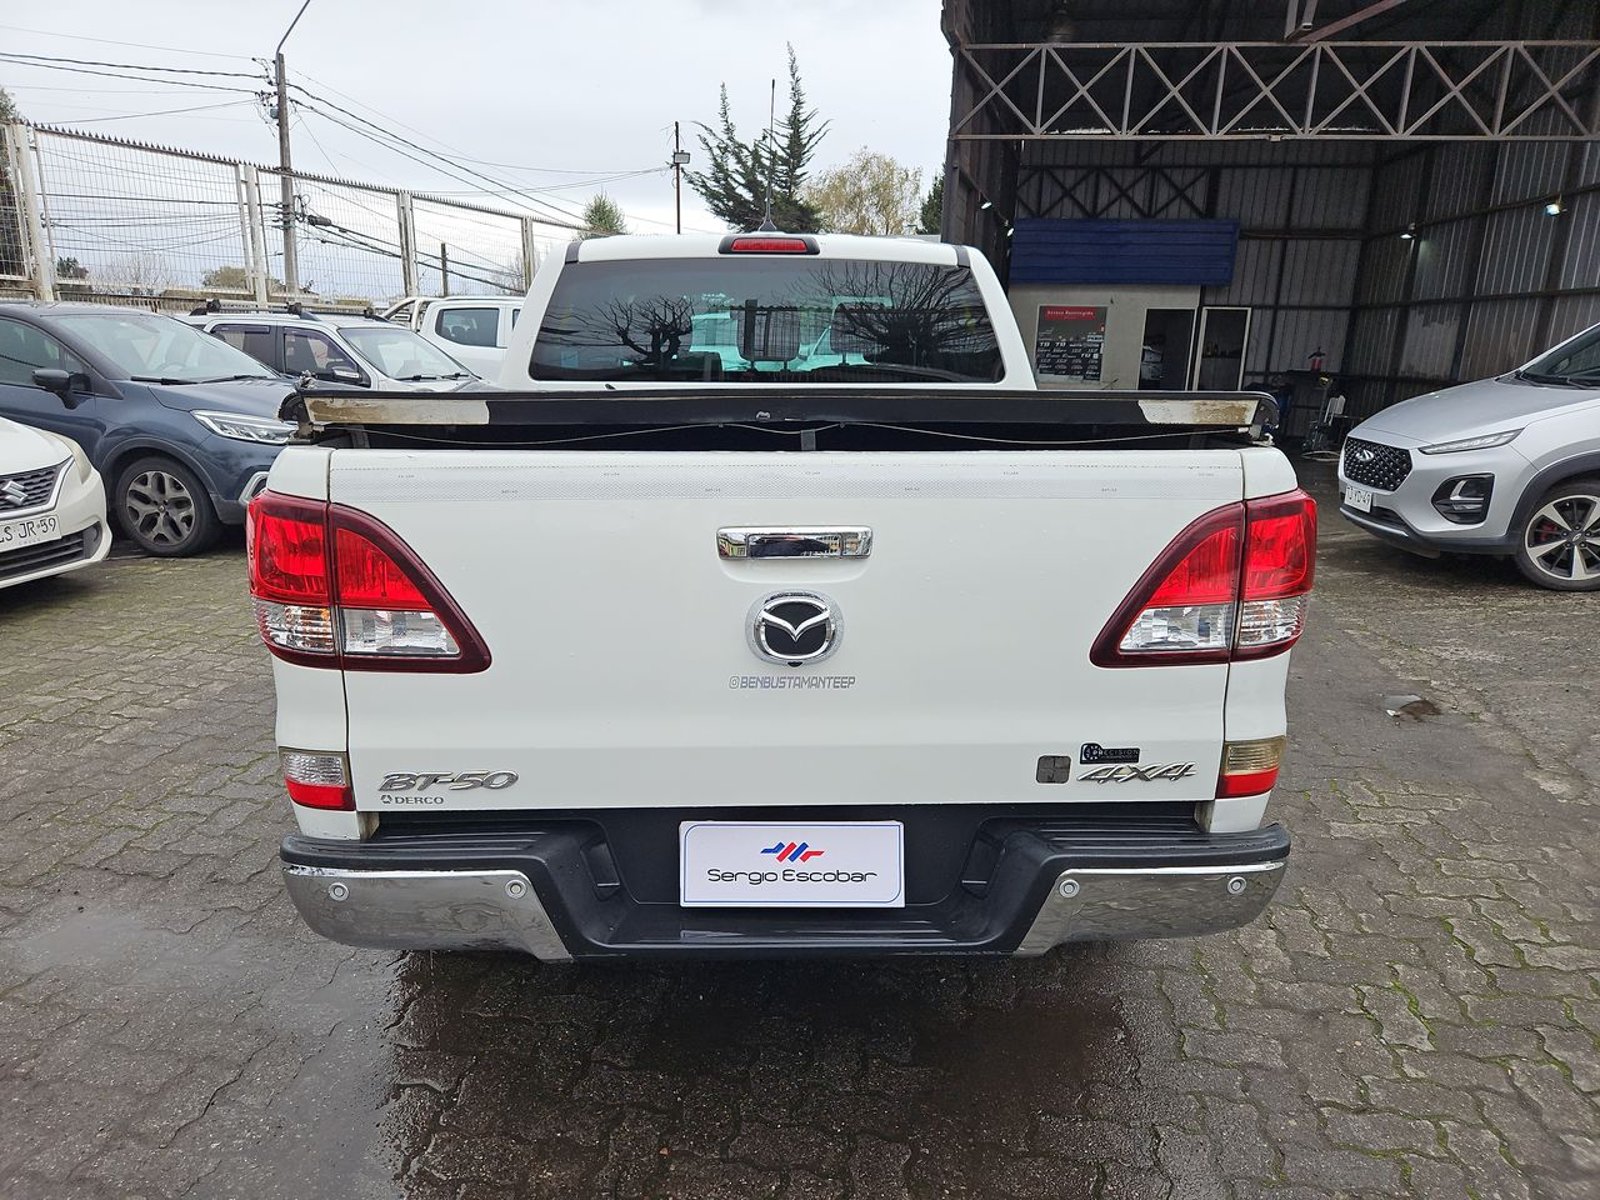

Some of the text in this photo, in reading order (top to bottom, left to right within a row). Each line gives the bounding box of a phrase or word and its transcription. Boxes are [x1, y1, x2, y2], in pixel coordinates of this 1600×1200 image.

[0, 526, 13, 543] S
[378, 770, 520, 791] BT-50
[394, 796, 445, 805] DERCO
[707, 868, 878, 885] Sergio Escobar
